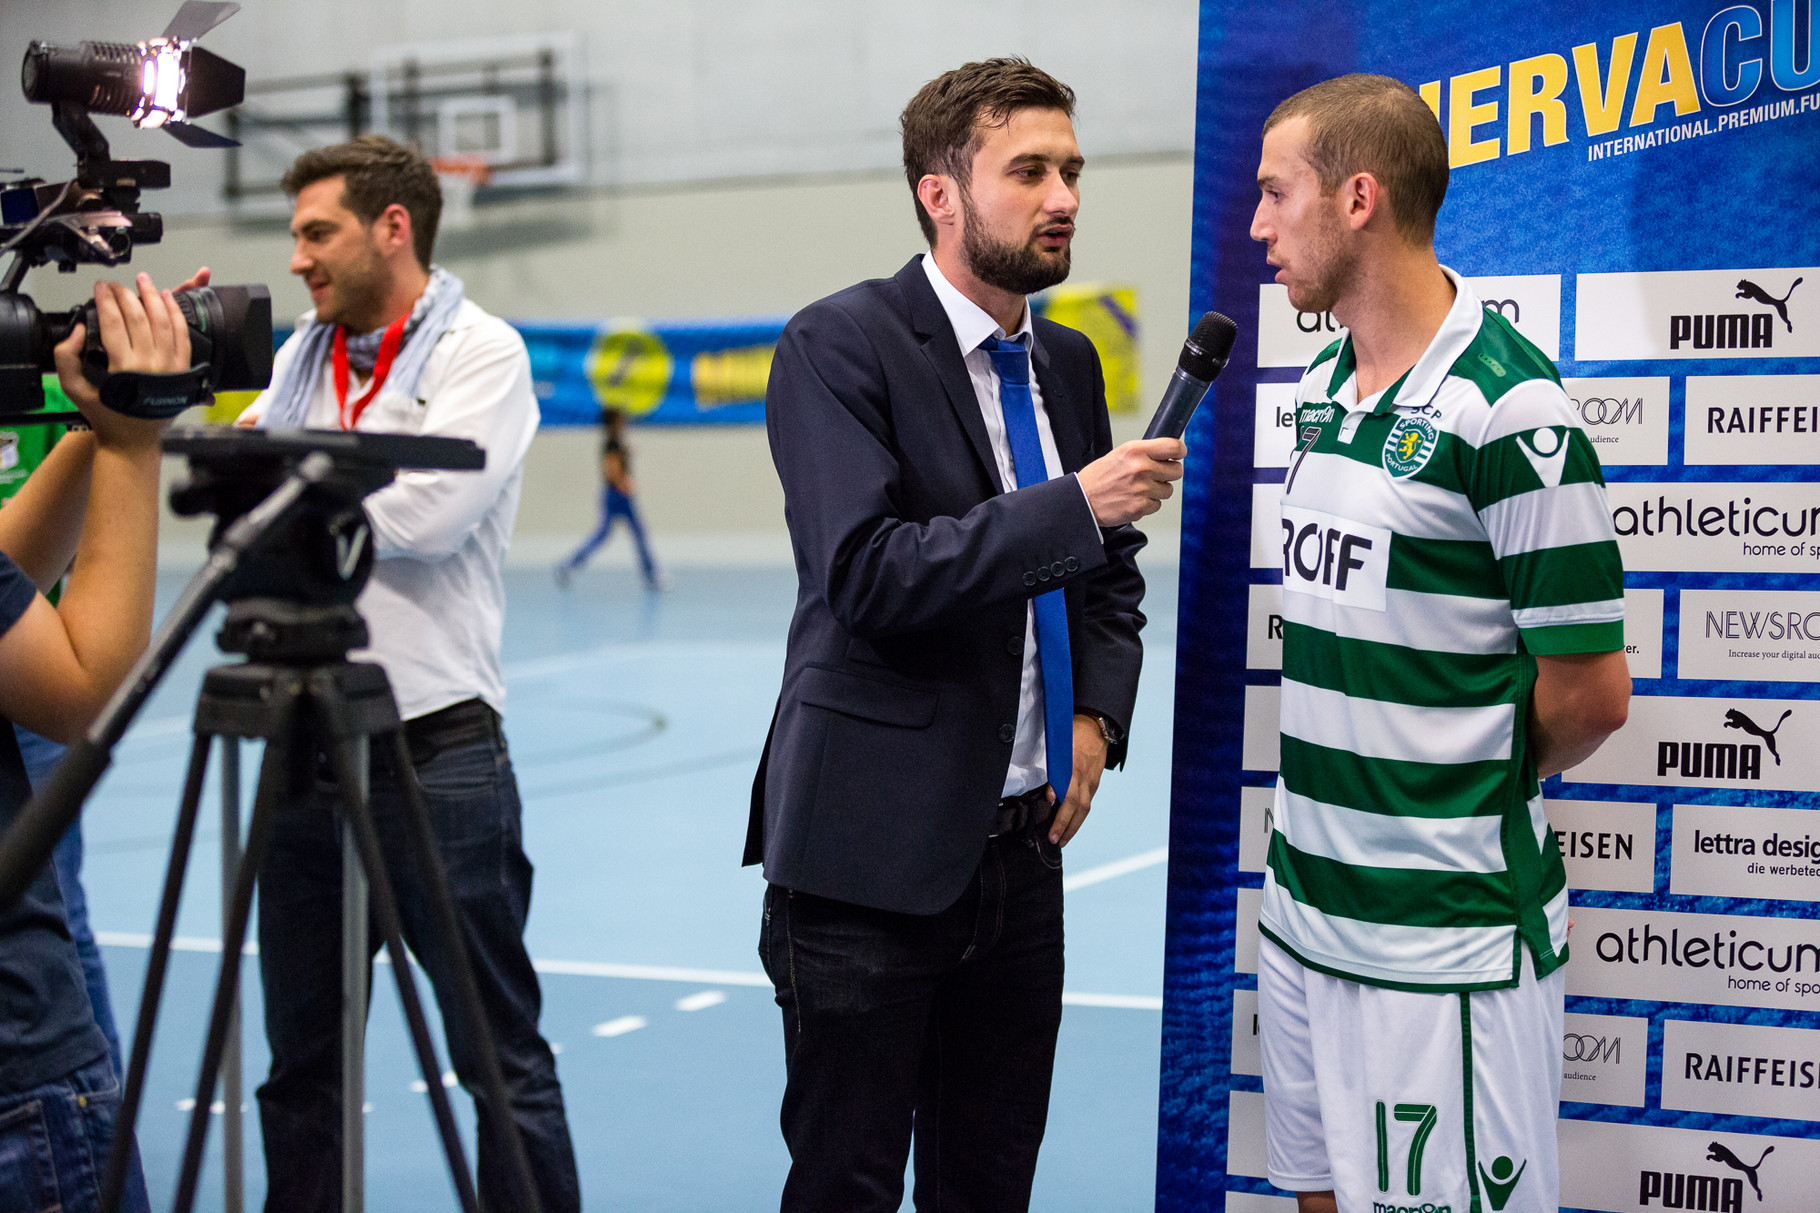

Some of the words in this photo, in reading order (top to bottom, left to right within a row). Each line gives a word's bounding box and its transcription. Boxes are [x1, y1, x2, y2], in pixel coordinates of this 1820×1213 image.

[1670, 313, 1773, 350] PUMA
[1399, 418, 1435, 441] SPORTING
[1707, 406, 1818, 434] RAIFFEI
[1590, 435, 1619, 443] udience
[1385, 453, 1418, 472] PORTUGAL
[1282, 518, 1373, 591] ROFF
[1743, 542, 1786, 556] home
[1790, 541, 1806, 556] of
[1728, 649, 1760, 658] Increase
[1761, 652, 1780, 660] your
[1781, 650, 1806, 661] digital
[1657, 741, 1761, 780] PUMA
[1694, 829, 1755, 855] lettra
[1747, 862, 1766, 875] die
[1728, 975, 1771, 991] home
[1775, 978, 1791, 993] of
[1563, 1072, 1597, 1081] audience
[1684, 1052, 1820, 1090] RAIFFEIS
[1375, 1099, 1438, 1197] 17
[1639, 1170, 1743, 1213] PUMA
